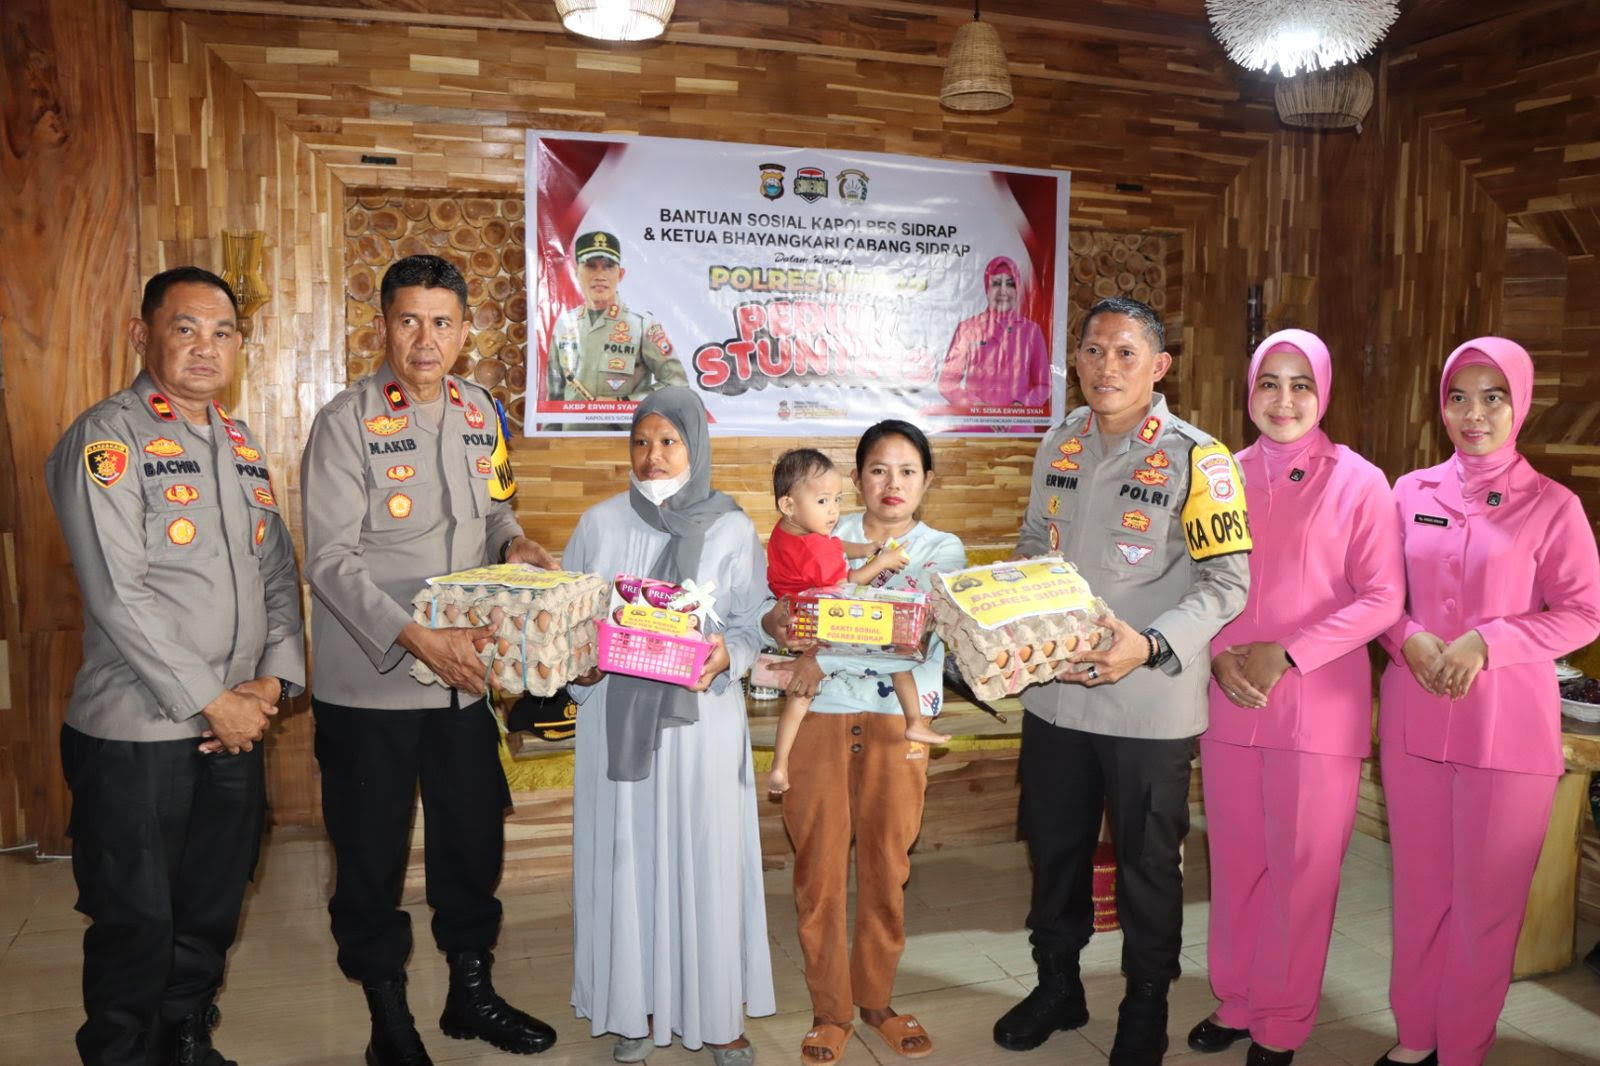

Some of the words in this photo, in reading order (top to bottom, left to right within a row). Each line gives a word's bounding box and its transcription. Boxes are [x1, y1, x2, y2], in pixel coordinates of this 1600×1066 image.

[660, 208, 742, 226] BANTUAN
[747, 213, 807, 230] SOSIAL
[812, 216, 897, 236] KAPOLRES
[901, 222, 957, 238] SIDRAP
[643, 227, 656, 241] &
[661, 228, 718, 244] KETUA
[723, 231, 840, 250] BHAYANGKARI
[844, 237, 911, 254] CABANG
[916, 241, 971, 257] SIDRAP
[709, 266, 822, 293] POLRES
[603, 343, 635, 354] POLRI
[143, 460, 201, 477] BACHRI
[1046, 474, 1079, 490] ERWIN
[1119, 483, 1170, 508] POLRI
[1185, 517, 1210, 551] KA
[1211, 510, 1243, 544] OPS
[622, 583, 640, 594] PRE
[1021, 577, 1074, 592] SOSIAL
[648, 590, 672, 600] PREN
